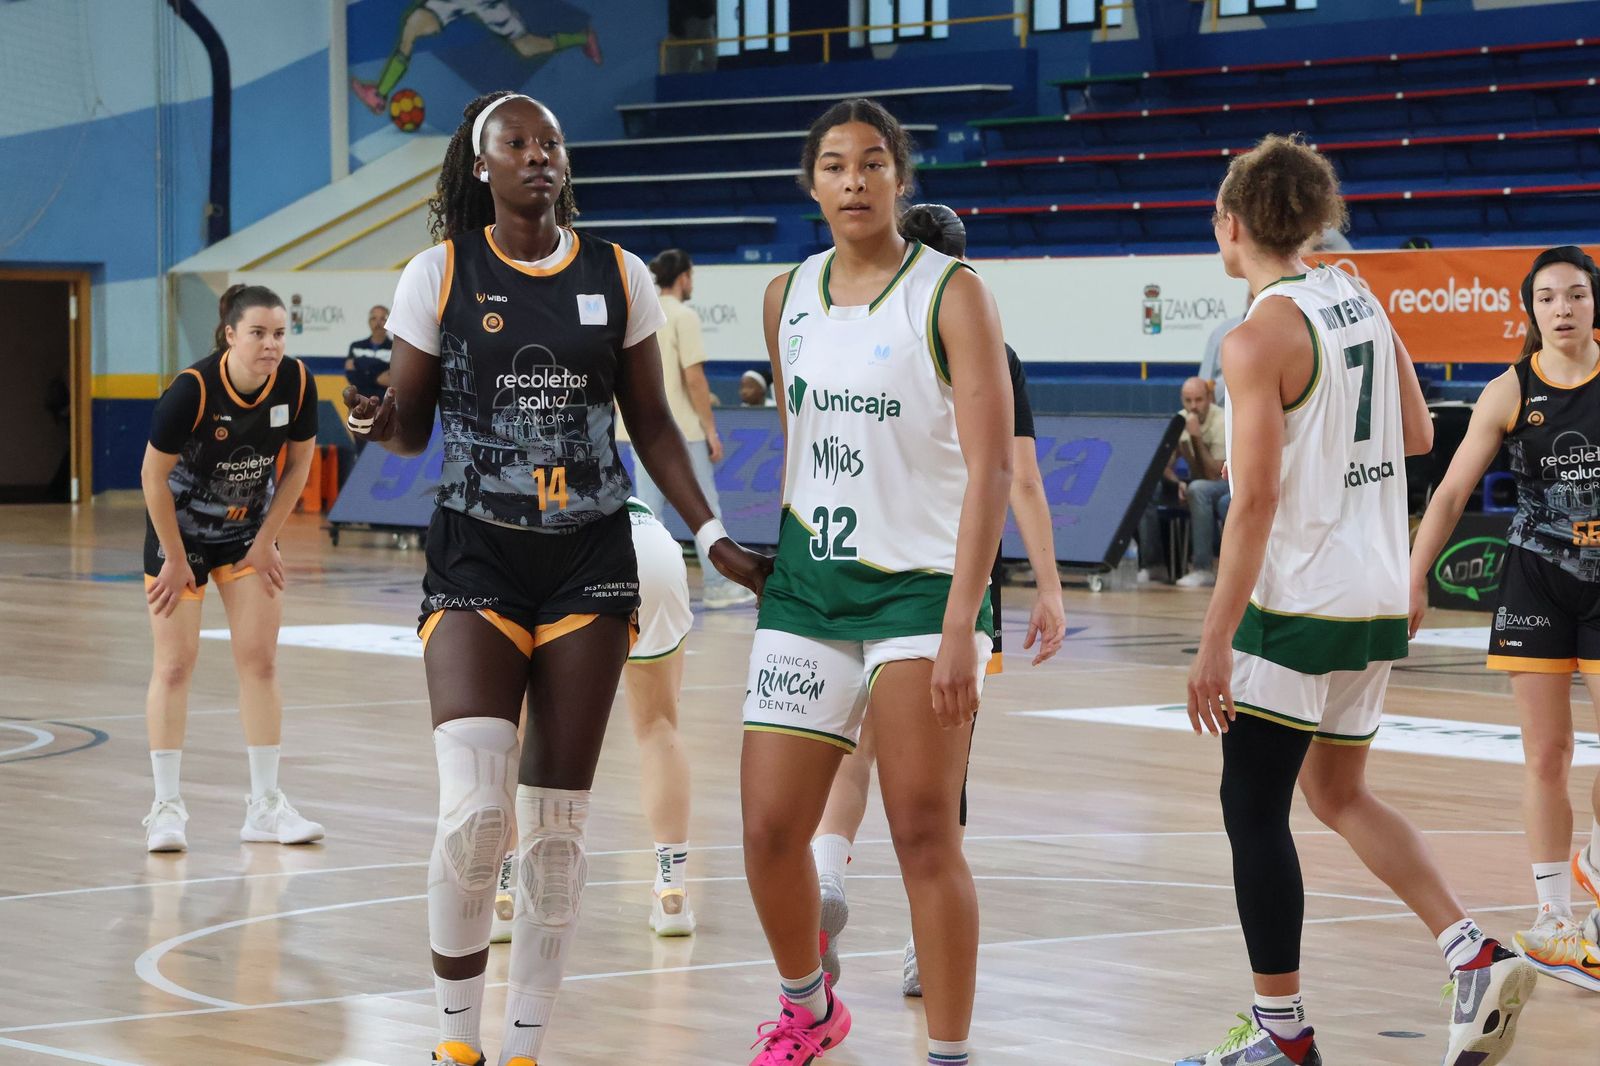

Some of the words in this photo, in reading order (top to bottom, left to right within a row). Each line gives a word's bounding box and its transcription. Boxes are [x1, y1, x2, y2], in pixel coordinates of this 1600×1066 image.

[487, 294, 508, 303] WIBO
[1389, 276, 1511, 314] recoletas
[1164, 298, 1228, 321] ZAMORA
[496, 368, 588, 389] recoletas
[518, 390, 570, 410] salud
[1343, 340, 1375, 443] 7
[812, 389, 901, 422] Unicaja
[513, 413, 575, 427] ZAMORA
[812, 435, 864, 486] Mijas
[532, 466, 570, 511] 14
[809, 504, 860, 561] 32
[1507, 613, 1551, 627] ZAMORA
[766, 653, 818, 670] CLINICAS
[759, 699, 808, 714] DENTAL
